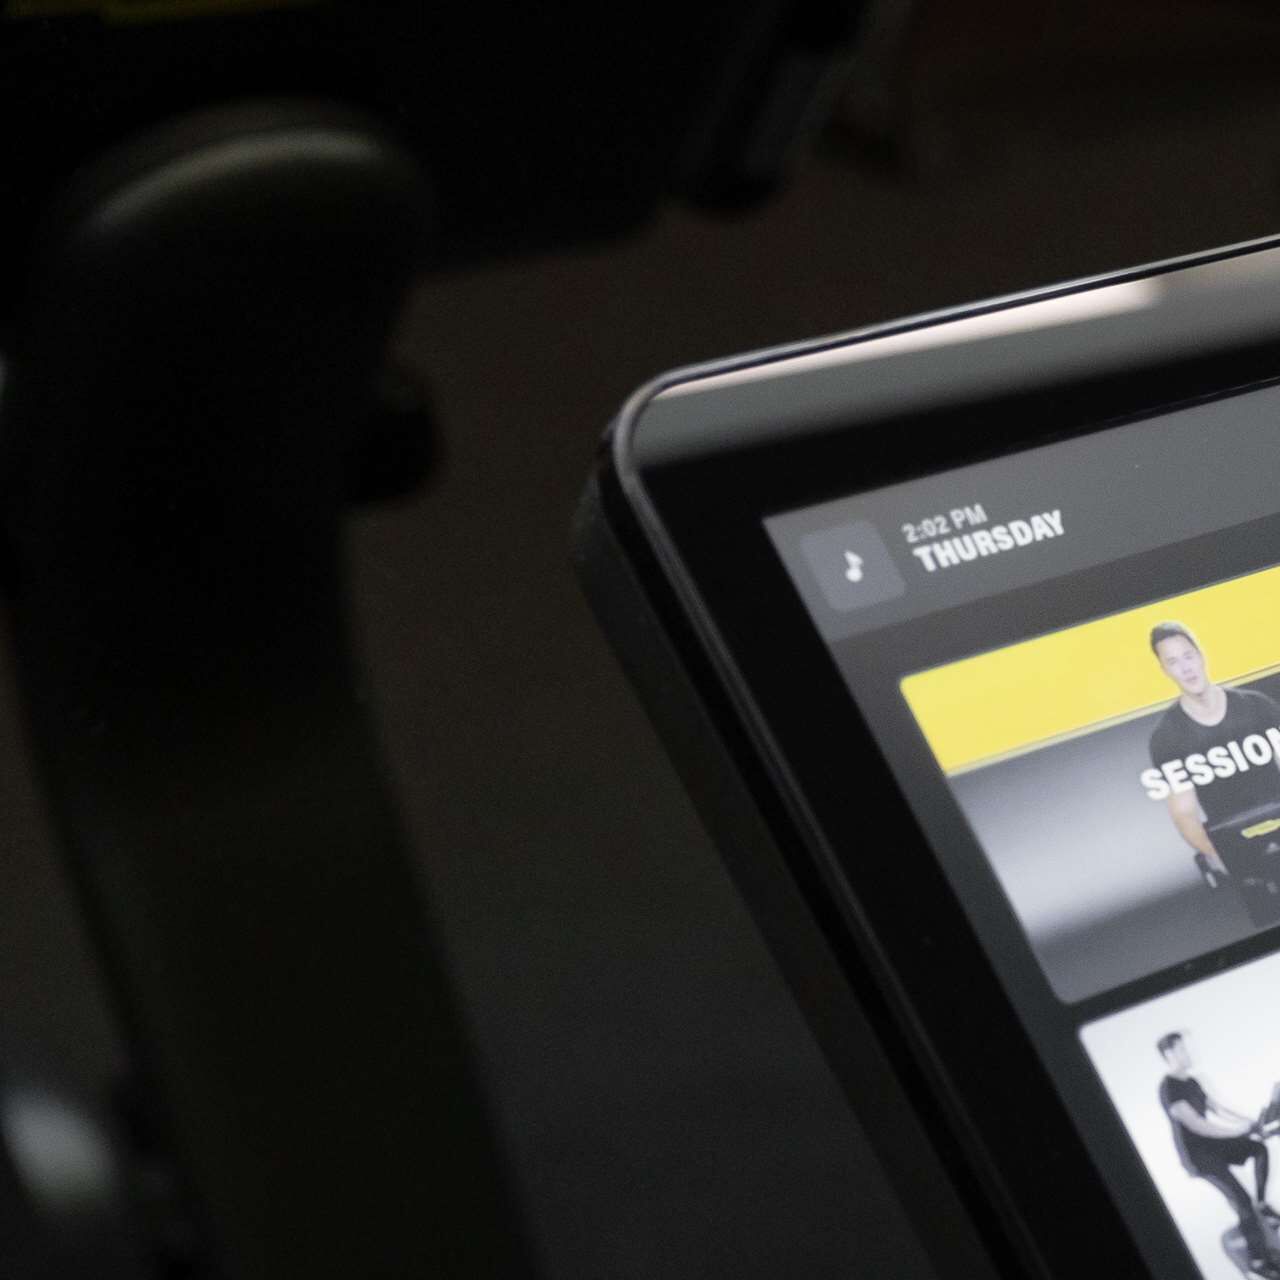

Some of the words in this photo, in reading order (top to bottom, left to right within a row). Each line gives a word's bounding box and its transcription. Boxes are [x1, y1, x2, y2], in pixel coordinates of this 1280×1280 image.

[902, 515, 950, 543] 2:02
[950, 503, 988, 529] PM
[912, 509, 1064, 572] THURSDAY
